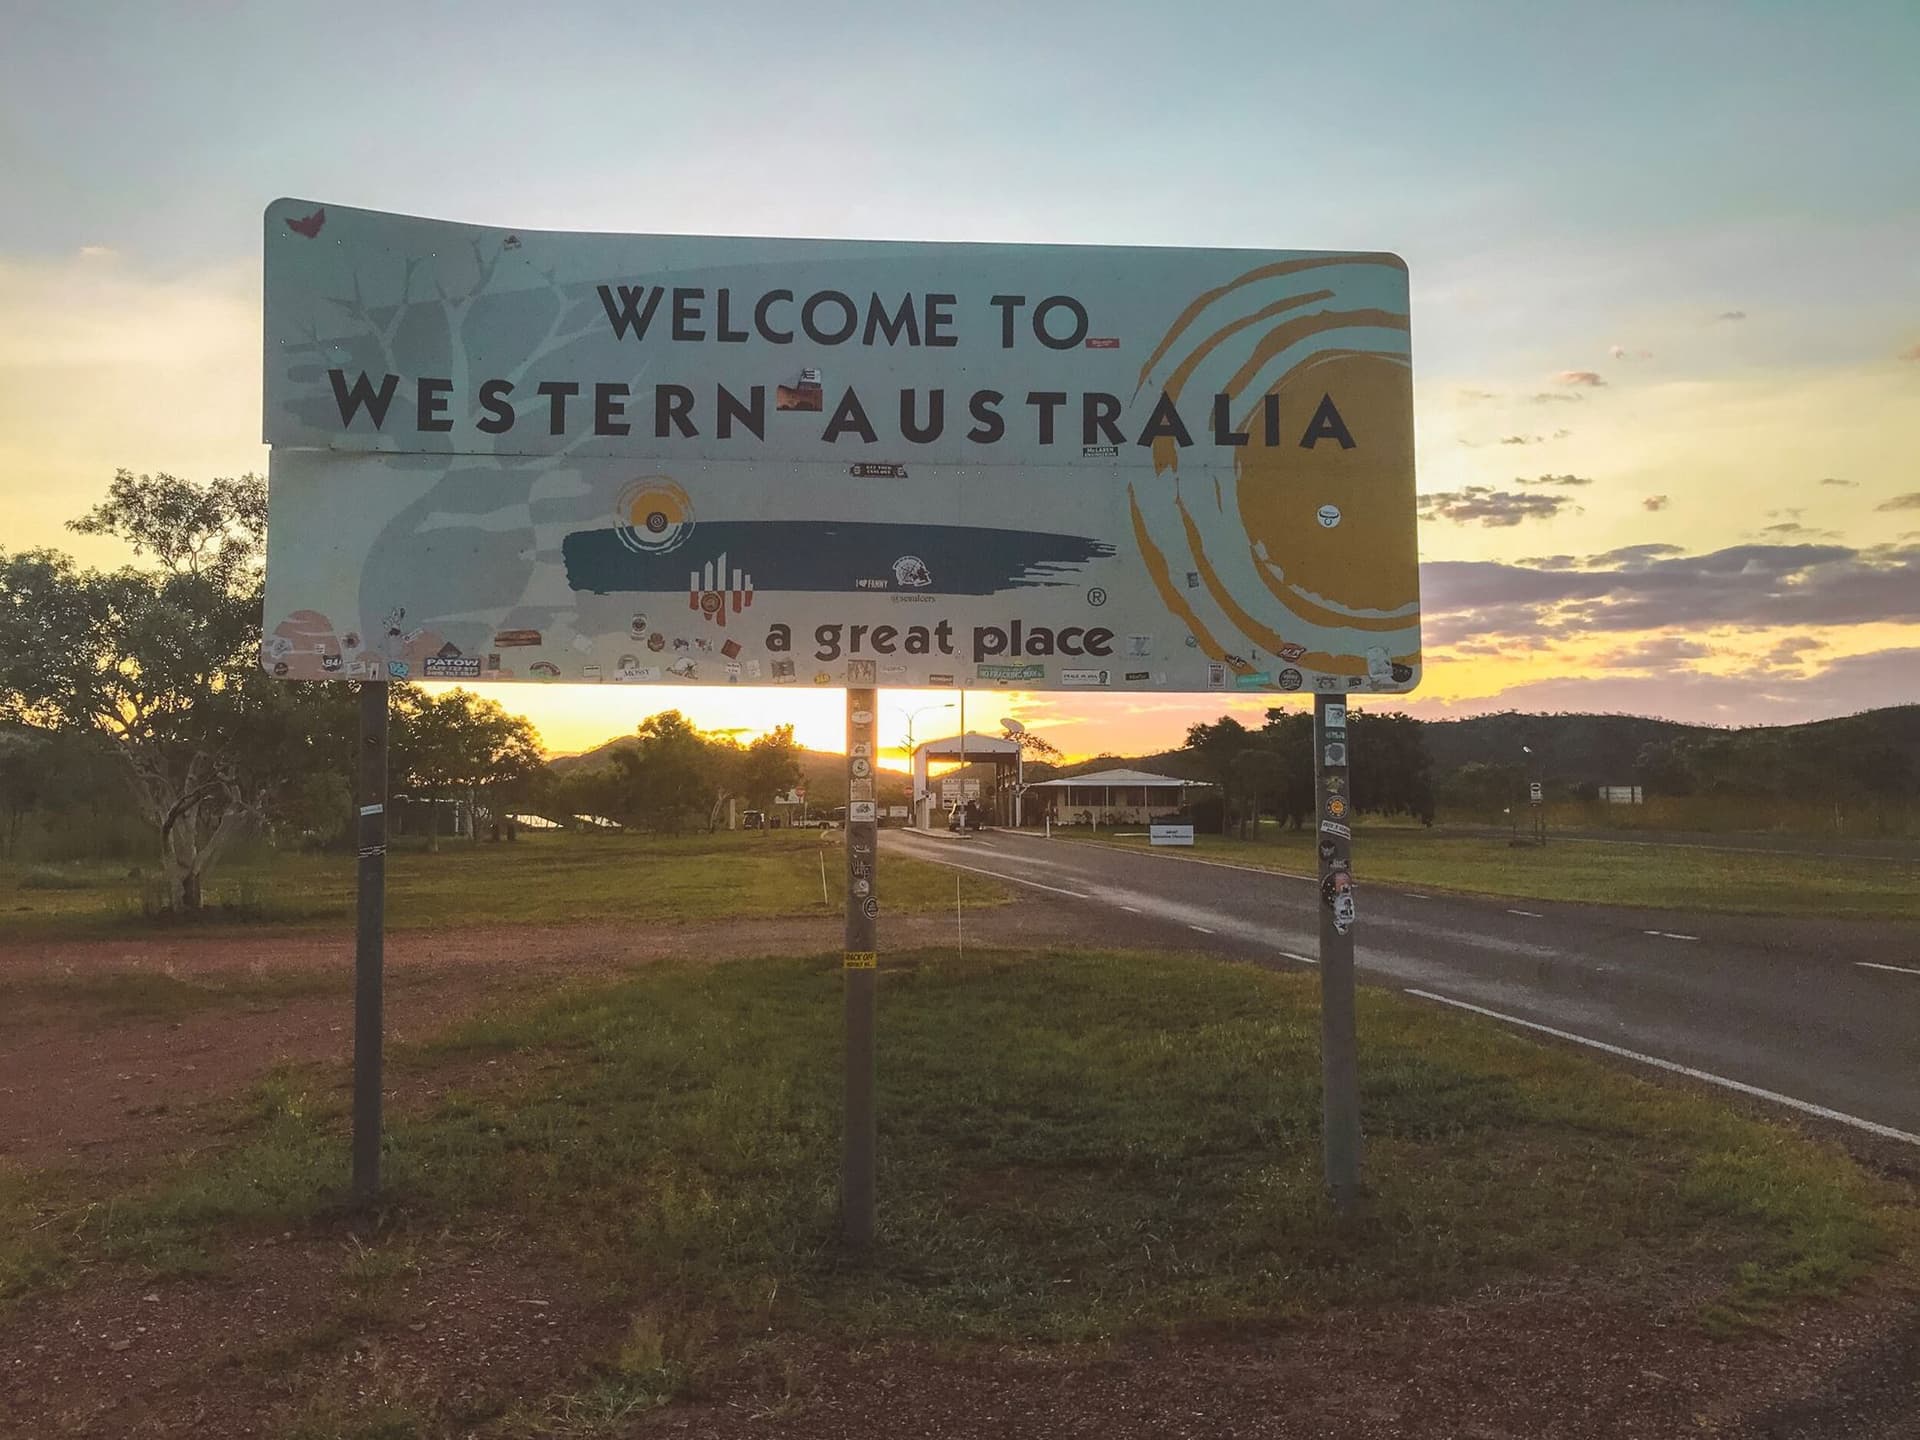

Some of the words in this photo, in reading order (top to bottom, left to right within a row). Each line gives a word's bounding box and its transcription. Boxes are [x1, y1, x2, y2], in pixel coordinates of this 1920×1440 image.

[597, 285, 959, 347] WELCOME
[990, 295, 1089, 350] TO
[327, 369, 766, 442] WESTERN
[820, 385, 1357, 451] AUSTRALIA
[427, 658, 479, 666] PATOW
[766, 623, 791, 652] a
[814, 619, 954, 662] great
[973, 619, 1115, 663] place
